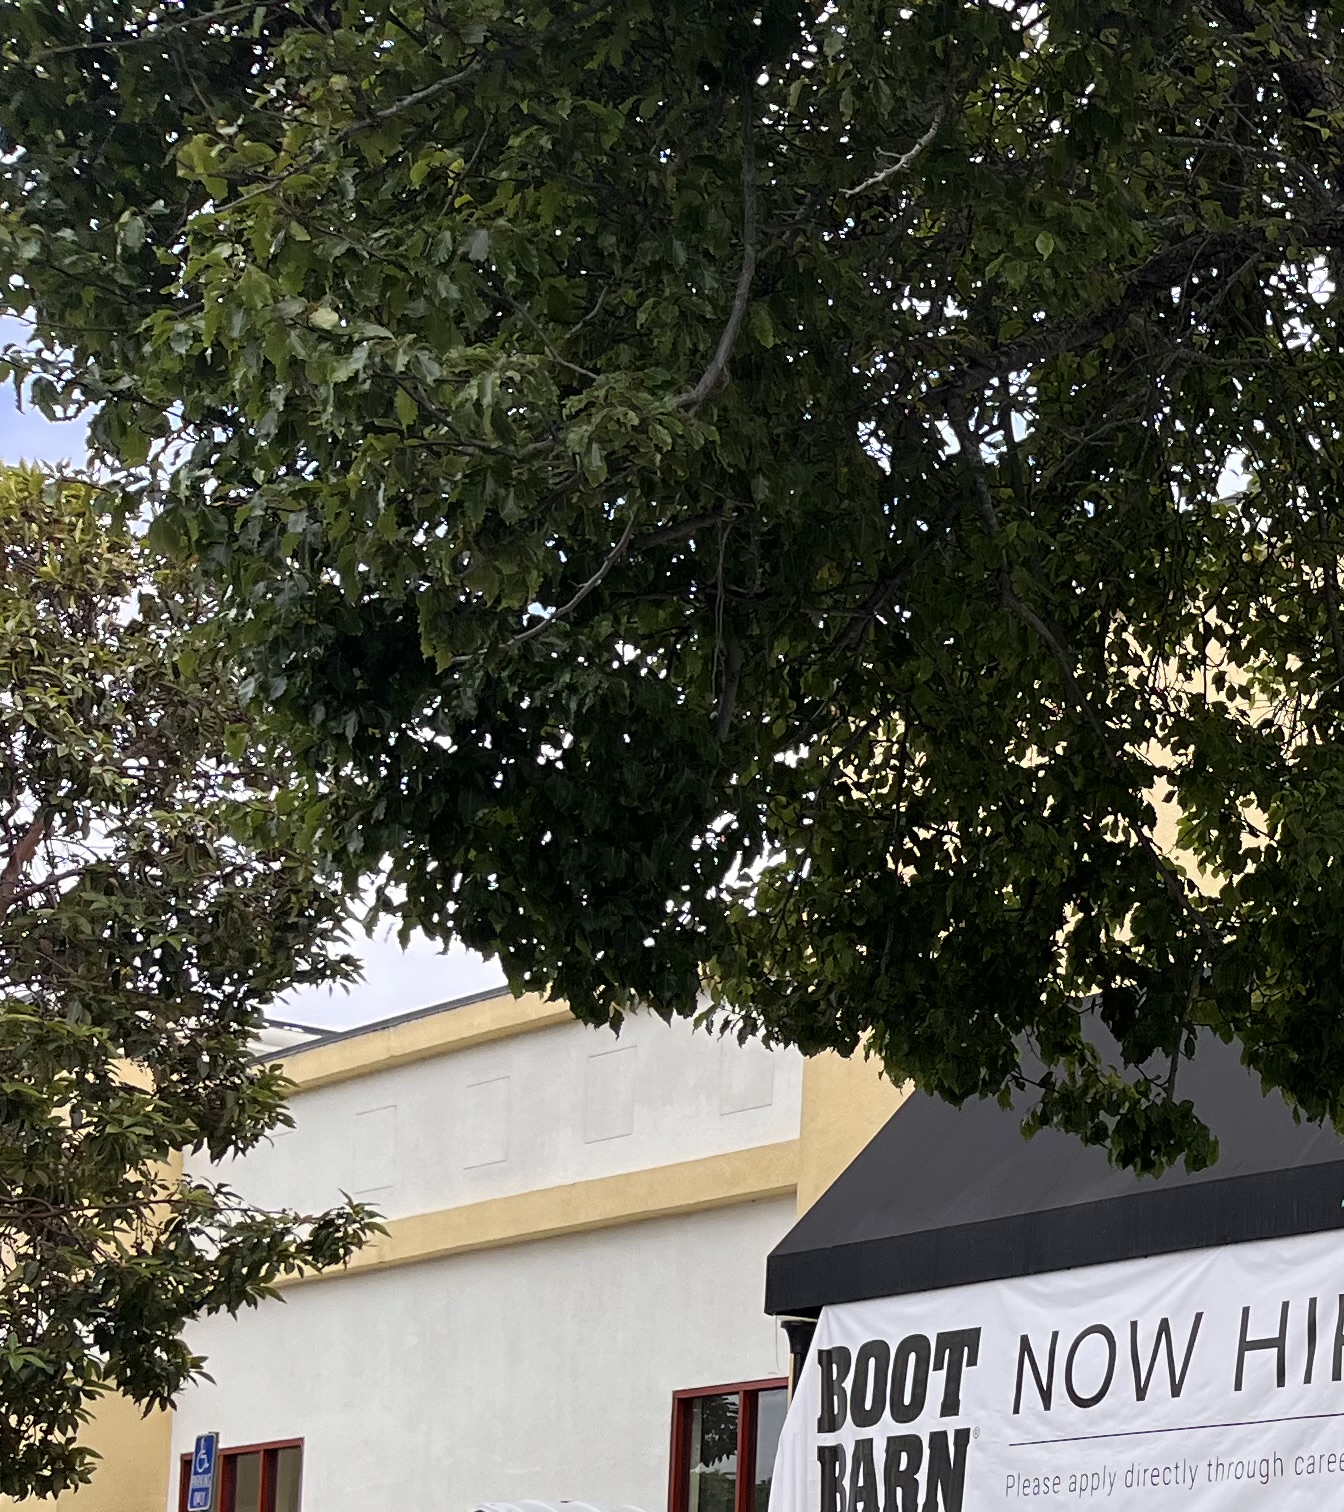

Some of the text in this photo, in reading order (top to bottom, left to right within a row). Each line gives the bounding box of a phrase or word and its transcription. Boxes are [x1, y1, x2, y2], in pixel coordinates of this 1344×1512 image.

[817, 1326, 982, 1434] BOOT
[1012, 1311, 1204, 1415] NOW
[1005, 1472, 1062, 1497] Please
[1069, 1464, 1117, 1498] apply
[1124, 1457, 1199, 1490] directly
[1206, 1450, 1285, 1485] through
